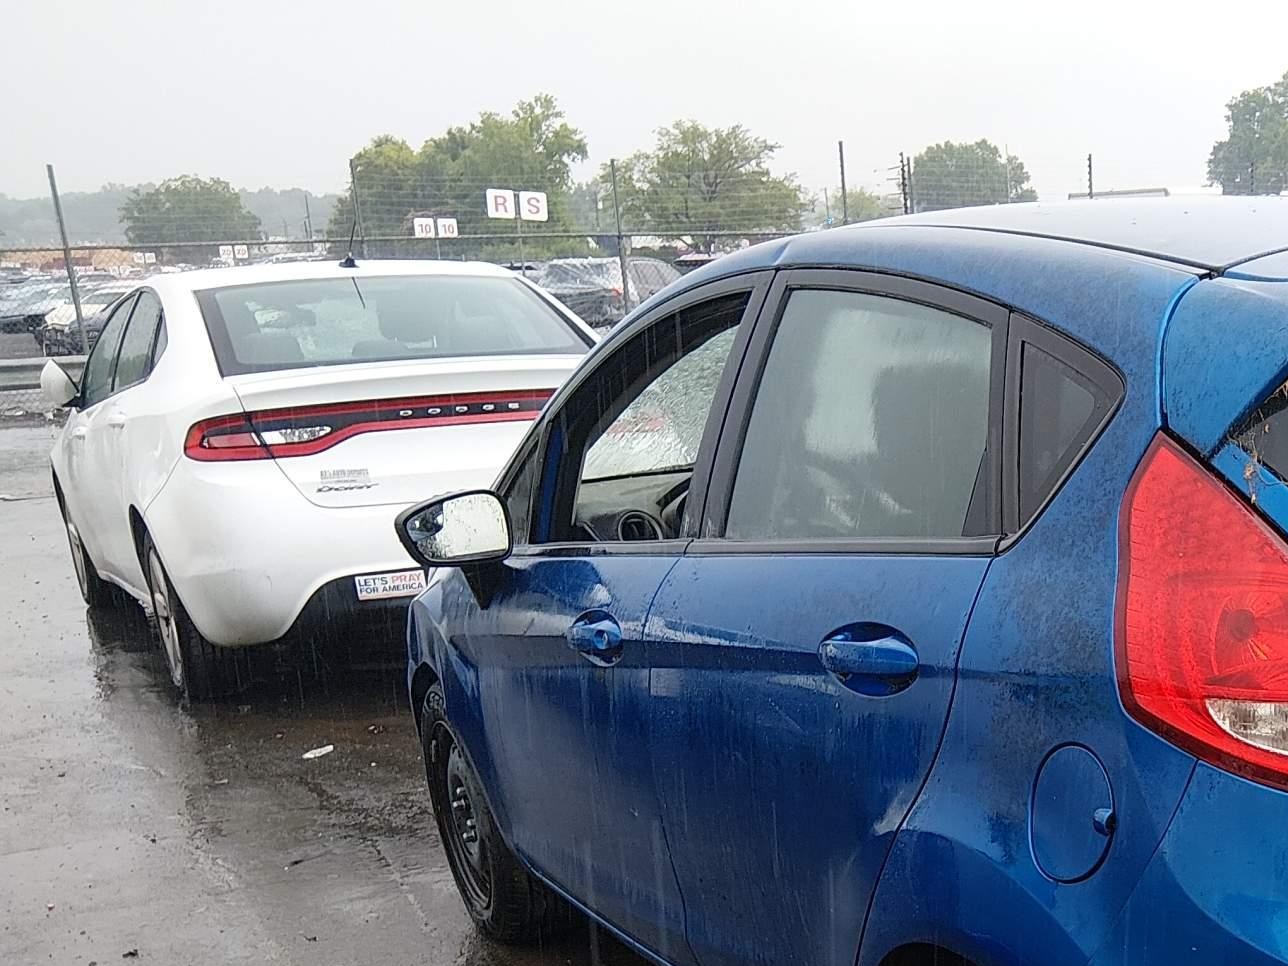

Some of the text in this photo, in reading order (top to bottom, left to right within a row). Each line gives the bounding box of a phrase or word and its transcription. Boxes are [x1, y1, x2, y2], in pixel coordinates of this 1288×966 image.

[494, 195, 508, 213] R
[527, 197, 541, 215] S
[418, 223, 432, 234] 10
[442, 223, 455, 234] 10
[357, 572, 423, 587] LET'S PRAY
[359, 582, 424, 595] FOR AMERICA
